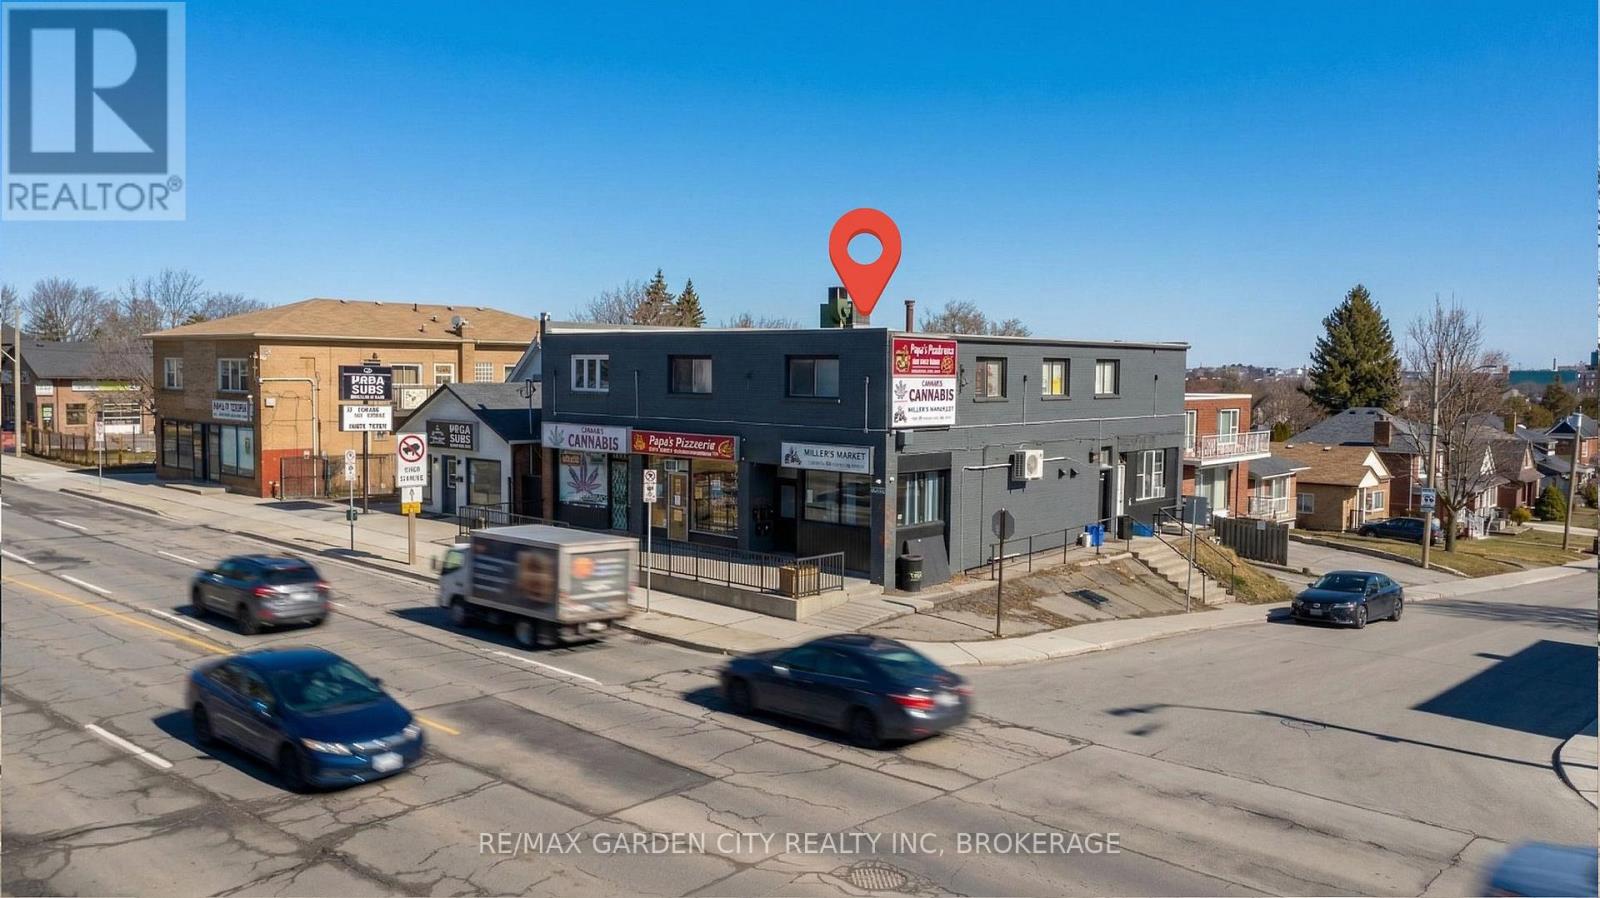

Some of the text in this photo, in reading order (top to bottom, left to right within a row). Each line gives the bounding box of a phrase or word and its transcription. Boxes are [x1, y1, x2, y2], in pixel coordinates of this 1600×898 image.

[351, 384, 384, 395] SUBS
[909, 388, 955, 402] CANNABIS
[449, 433, 471, 444] SUBS
[568, 433, 619, 451] CANNABIS
[648, 434, 674, 449] Papa's
[804, 448, 866, 461] MILLER'S MARKET
